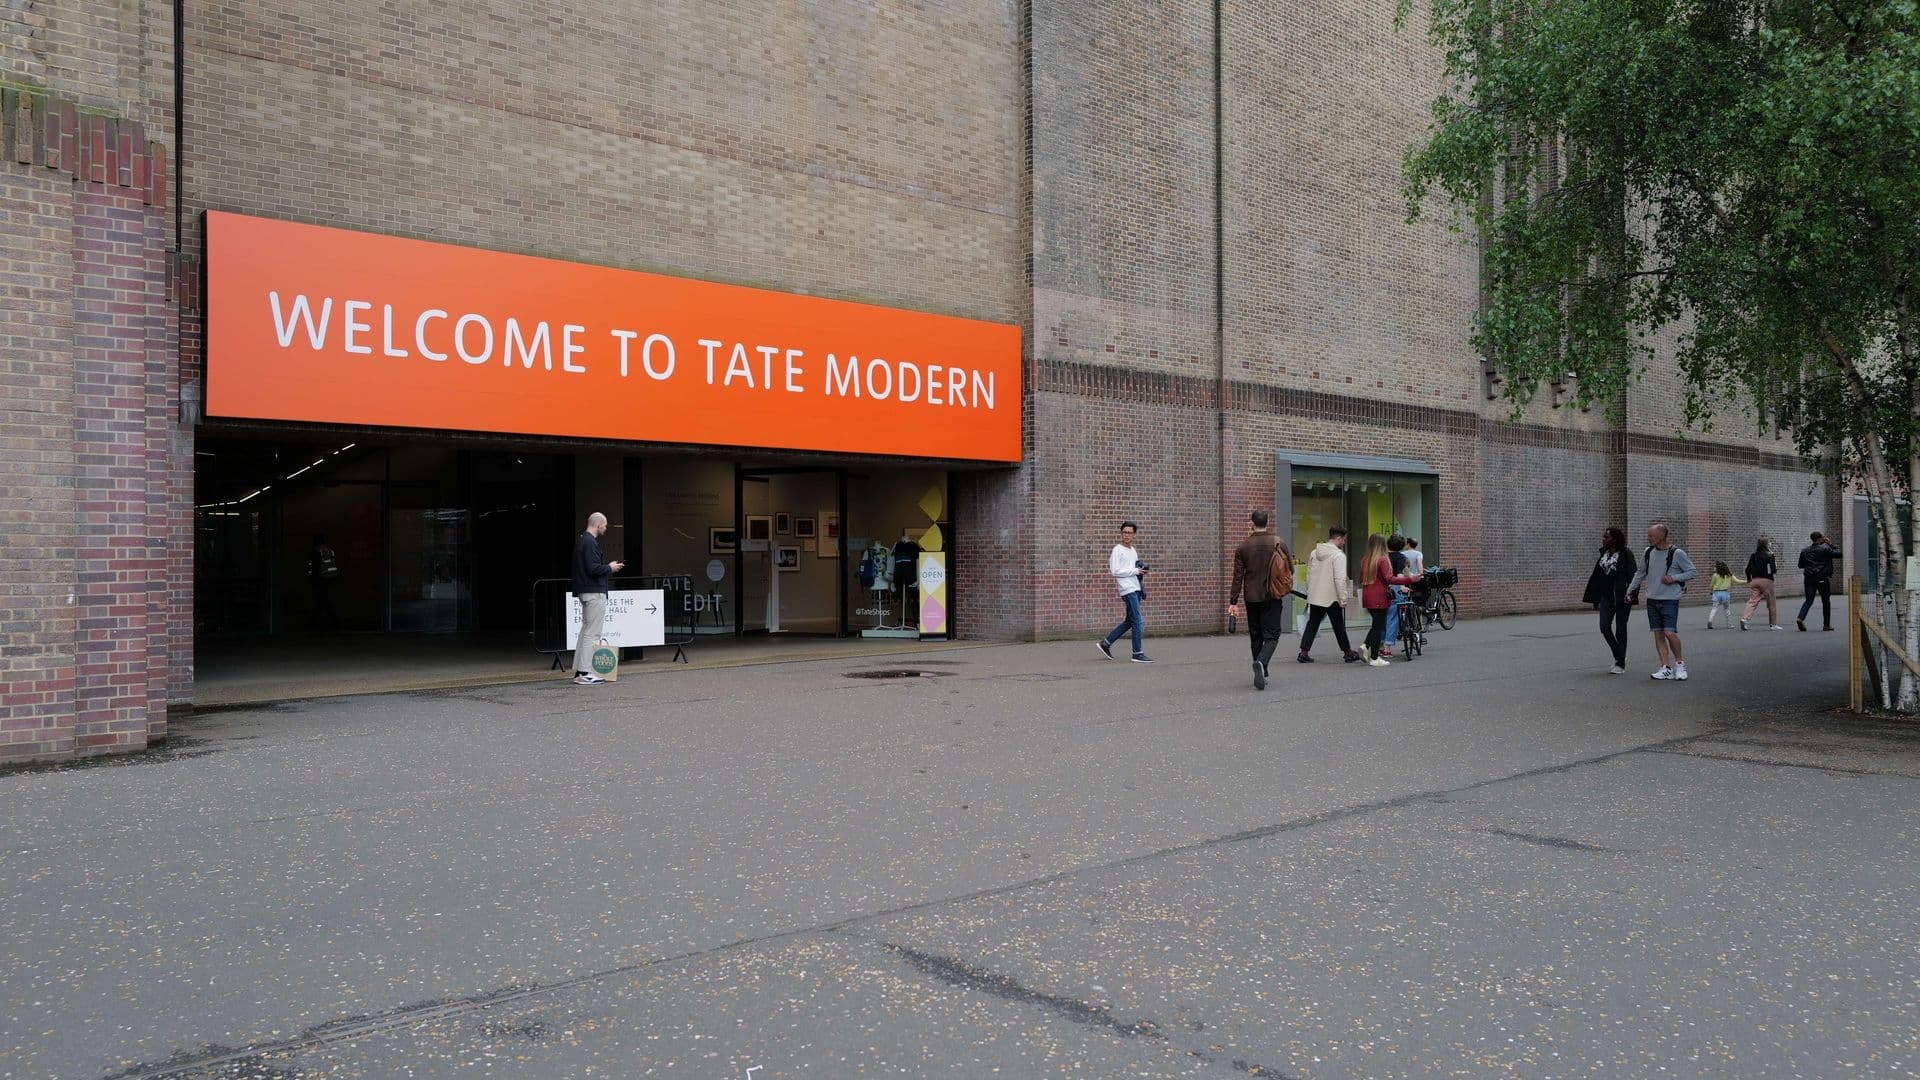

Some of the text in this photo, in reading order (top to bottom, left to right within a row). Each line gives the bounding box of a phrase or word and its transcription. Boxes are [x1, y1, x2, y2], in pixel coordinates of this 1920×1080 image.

[269, 290, 995, 410] WELCOME TO TATE MODERN
[922, 571, 943, 579] OPEN
[684, 594, 723, 612] EDIT
[609, 606, 628, 614] HALL
